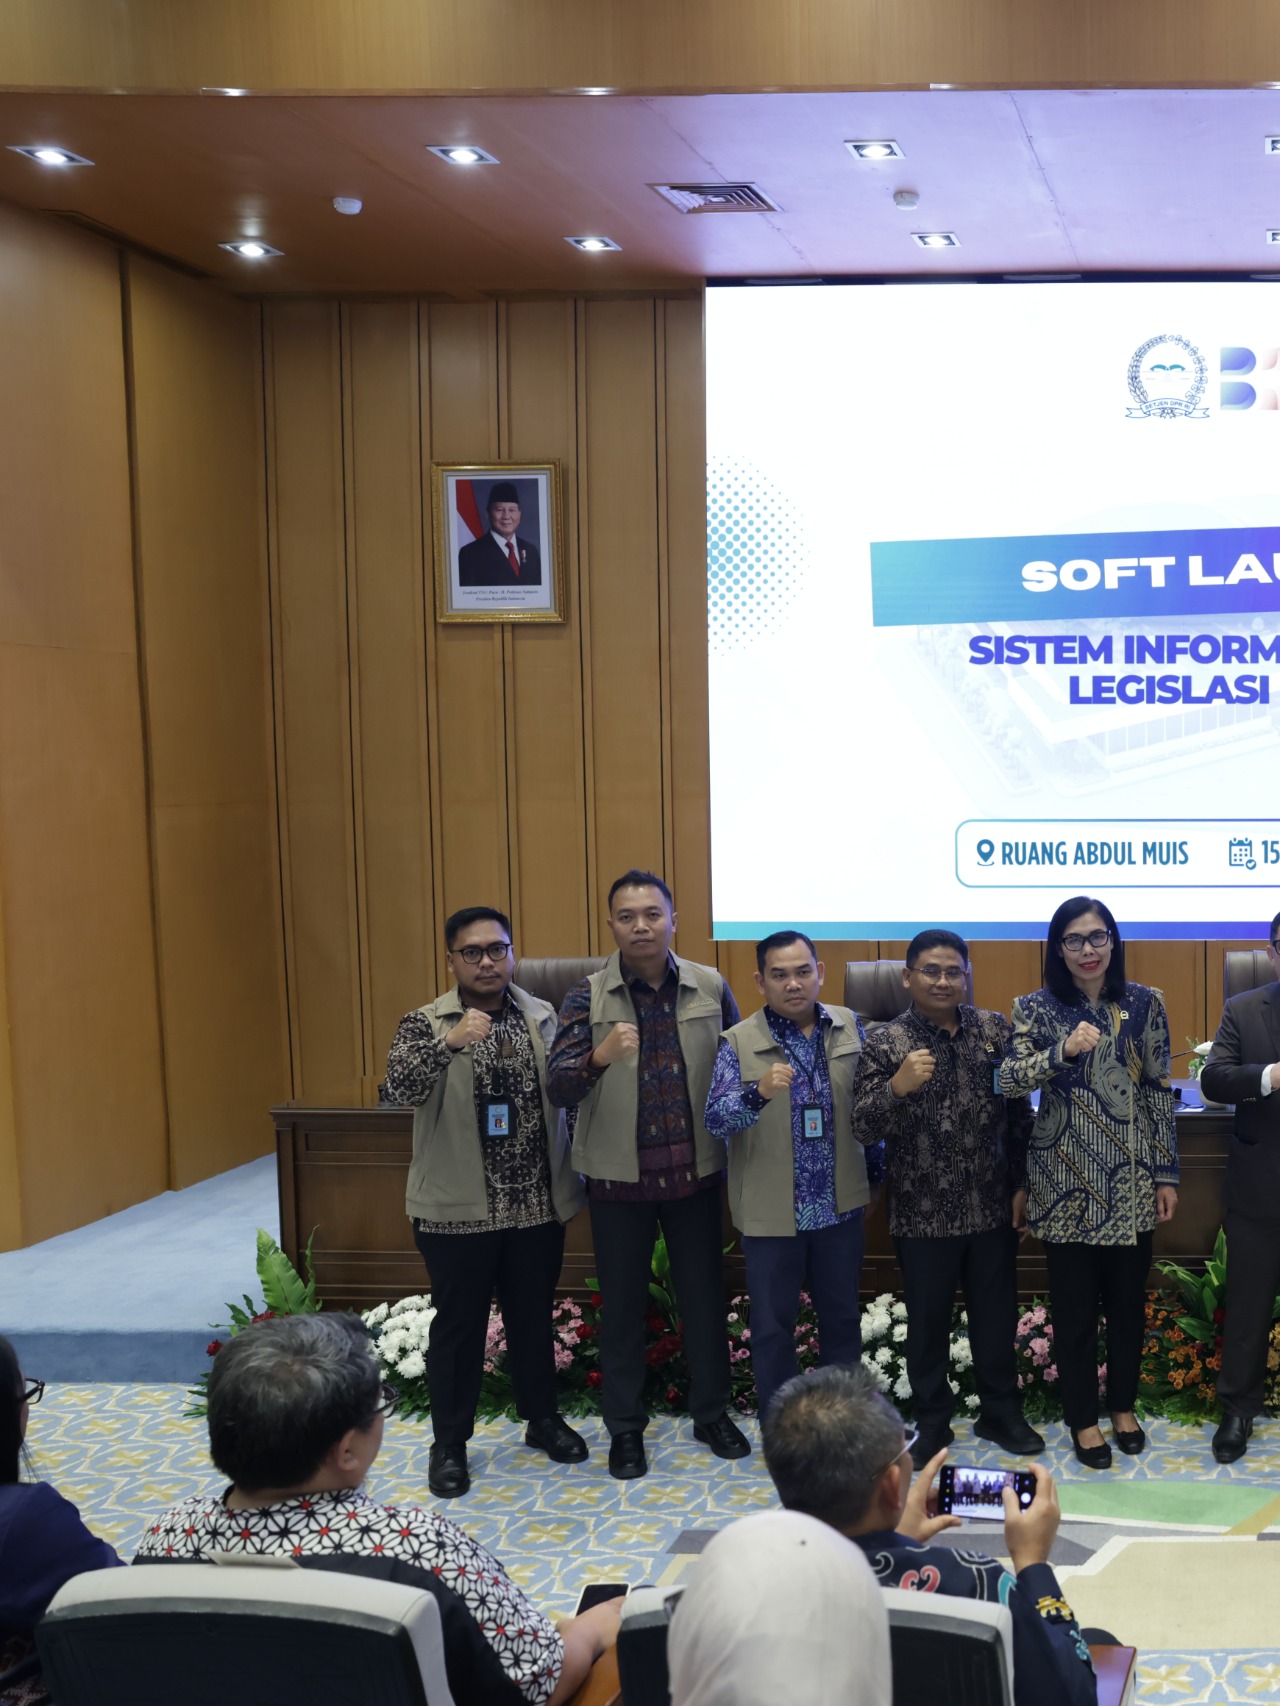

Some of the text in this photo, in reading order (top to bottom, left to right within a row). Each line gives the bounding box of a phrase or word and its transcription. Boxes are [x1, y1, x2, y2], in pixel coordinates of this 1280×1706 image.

[1145, 401, 1168, 410] SETJEN
[1020, 557, 1176, 592] SOFT
[968, 634, 1114, 666] SISTEM
[1069, 674, 1270, 705] LEGISLASI
[1001, 840, 1190, 866] RUANG ABDUL MUIS
[1261, 839, 1280, 865] 15
